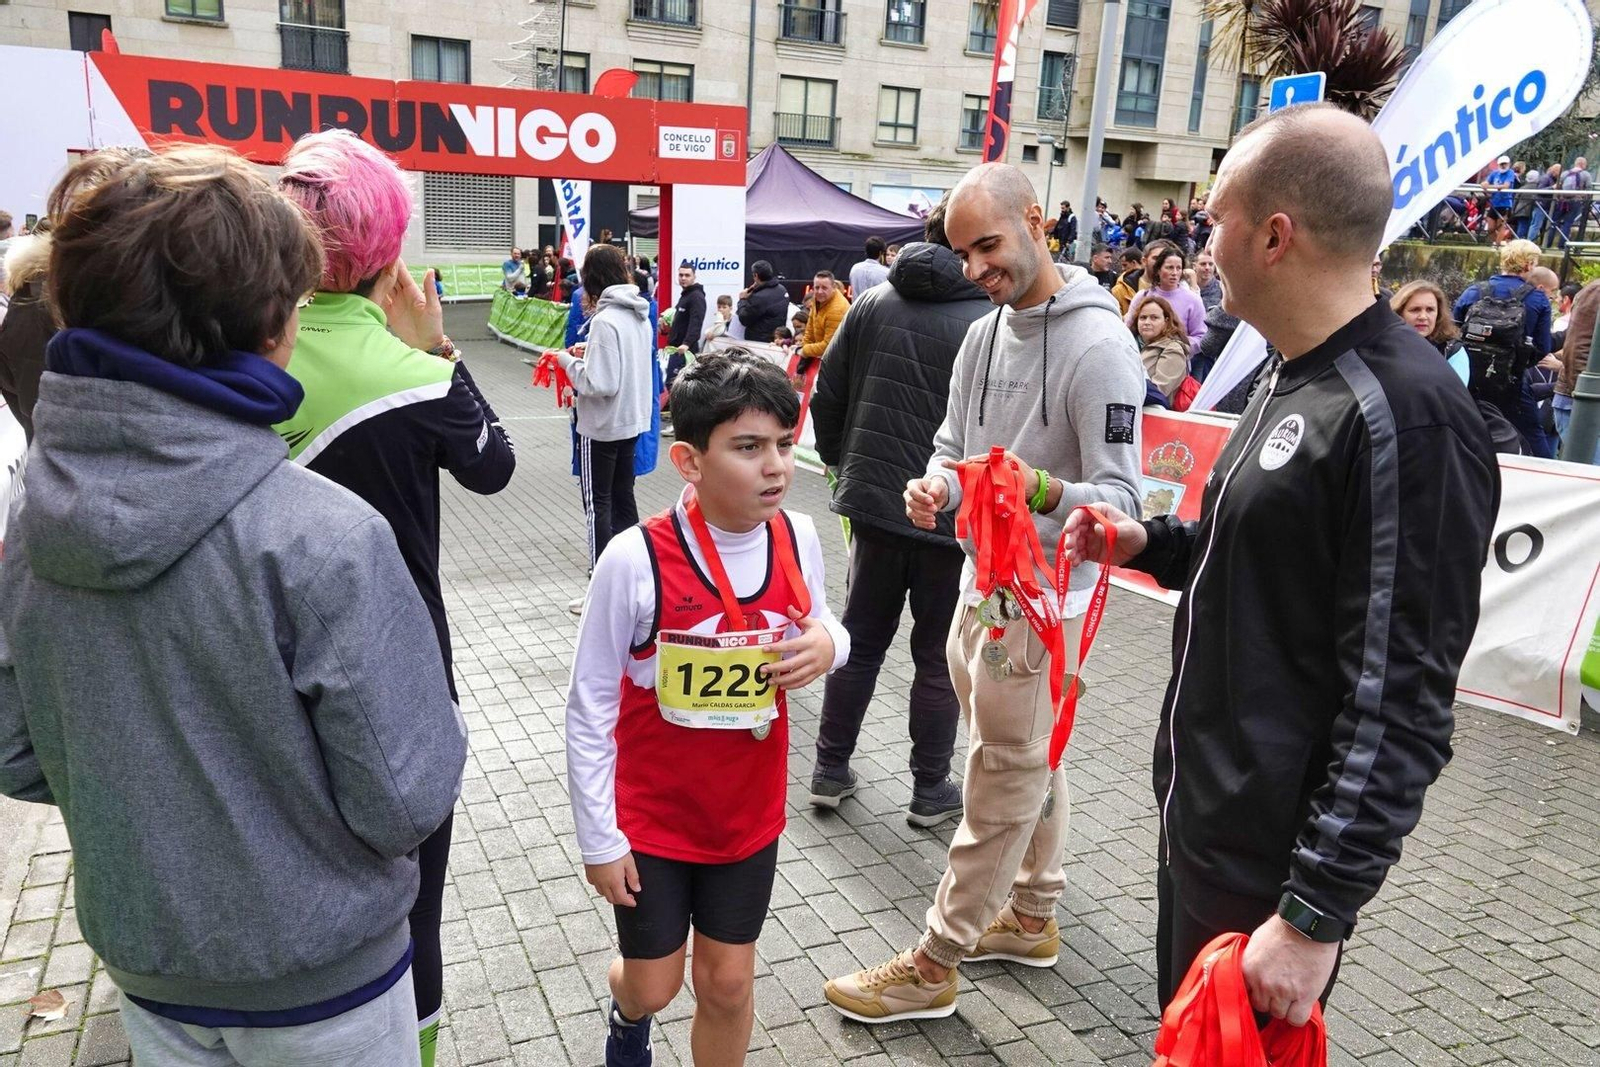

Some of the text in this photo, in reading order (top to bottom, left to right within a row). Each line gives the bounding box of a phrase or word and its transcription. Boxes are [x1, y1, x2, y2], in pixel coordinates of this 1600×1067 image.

[147, 79, 617, 164] RUNRUNVIGO
[663, 133, 711, 143] CONCELLO
[669, 143, 706, 152] DE VIGO
[1008, 380, 1029, 390] PARK
[675, 603, 702, 612] amura
[1086, 597, 1102, 638] CONCELLO
[1097, 585, 1106, 597] DE
[1031, 616, 1043, 632] VIGO
[667, 633, 748, 648] RUNRUNVIGO
[677, 662, 773, 698] 1229
